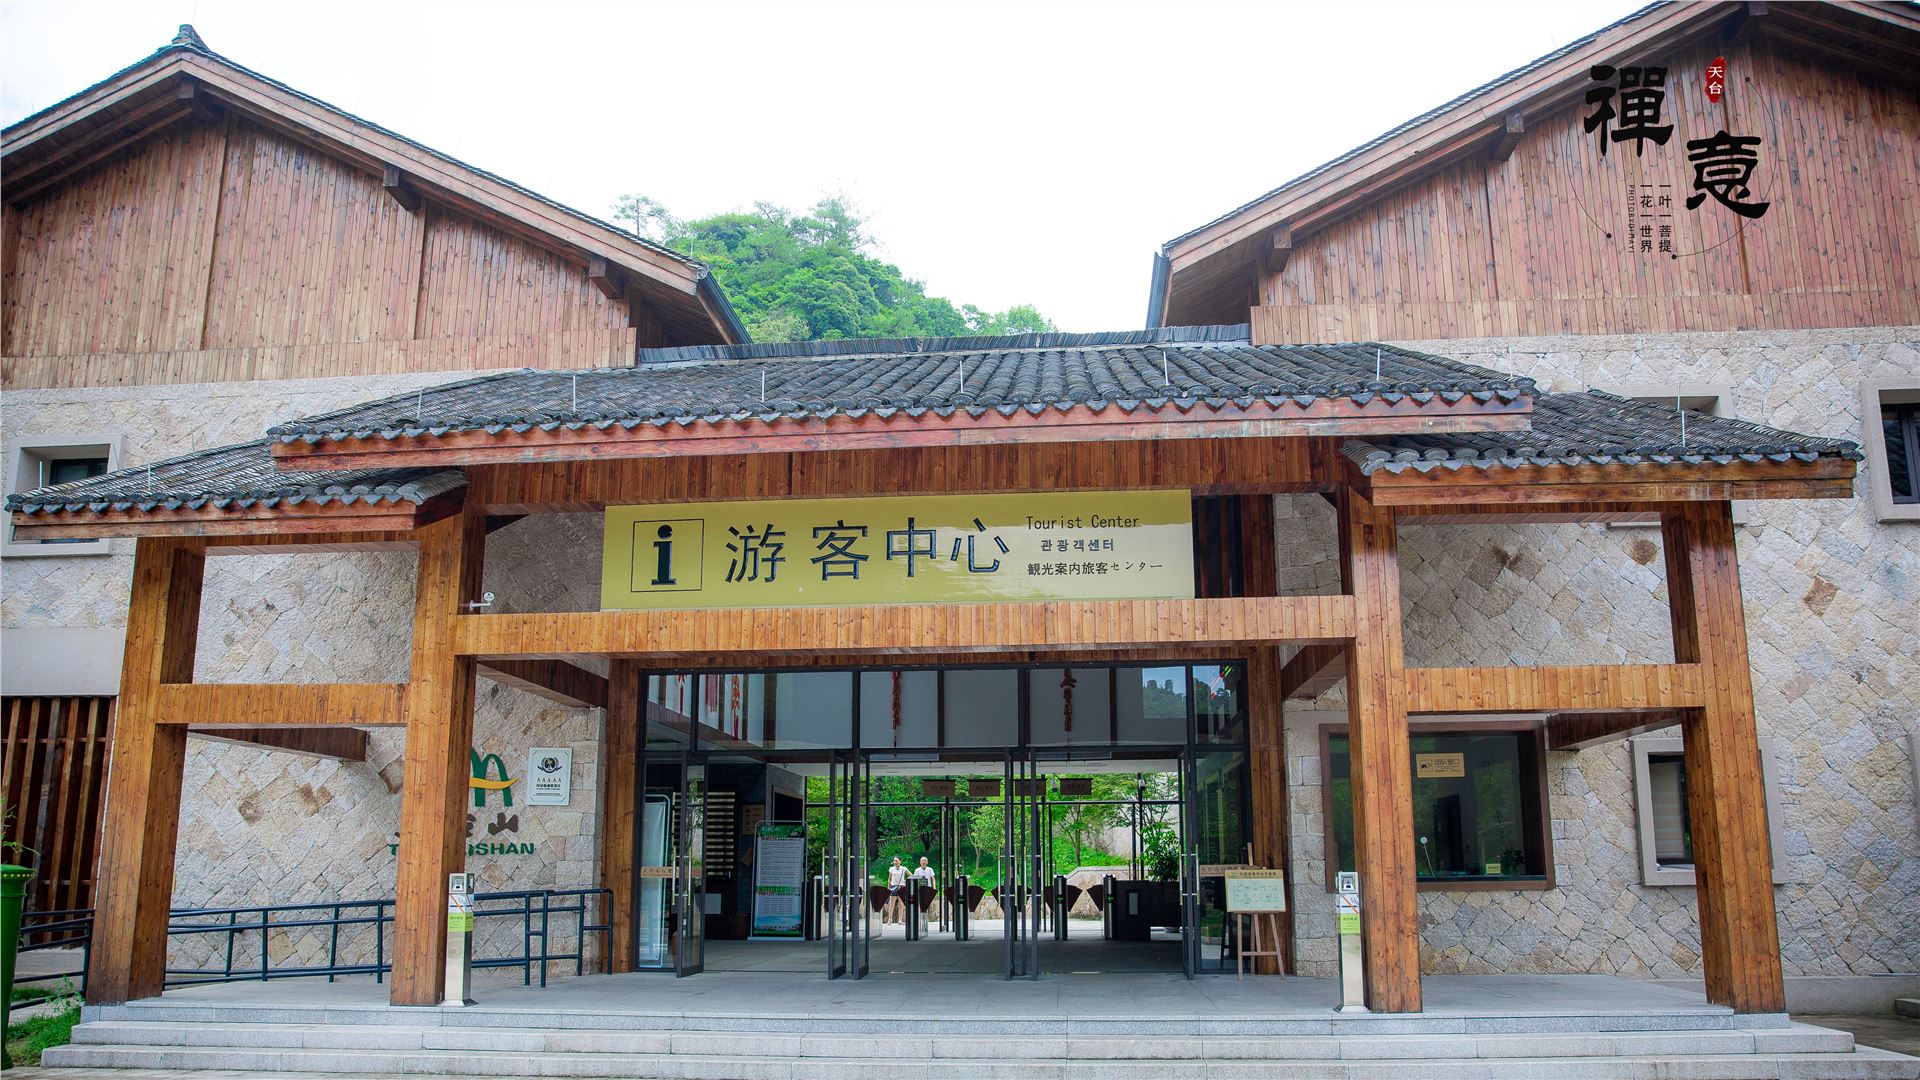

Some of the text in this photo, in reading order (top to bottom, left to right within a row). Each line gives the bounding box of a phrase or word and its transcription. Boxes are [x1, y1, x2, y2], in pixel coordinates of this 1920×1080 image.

[1026, 514, 1140, 530] Tourist Center
[725, 517, 1010, 583] 游客中心
[1028, 562, 1162, 576] 観光案内旅客センター
